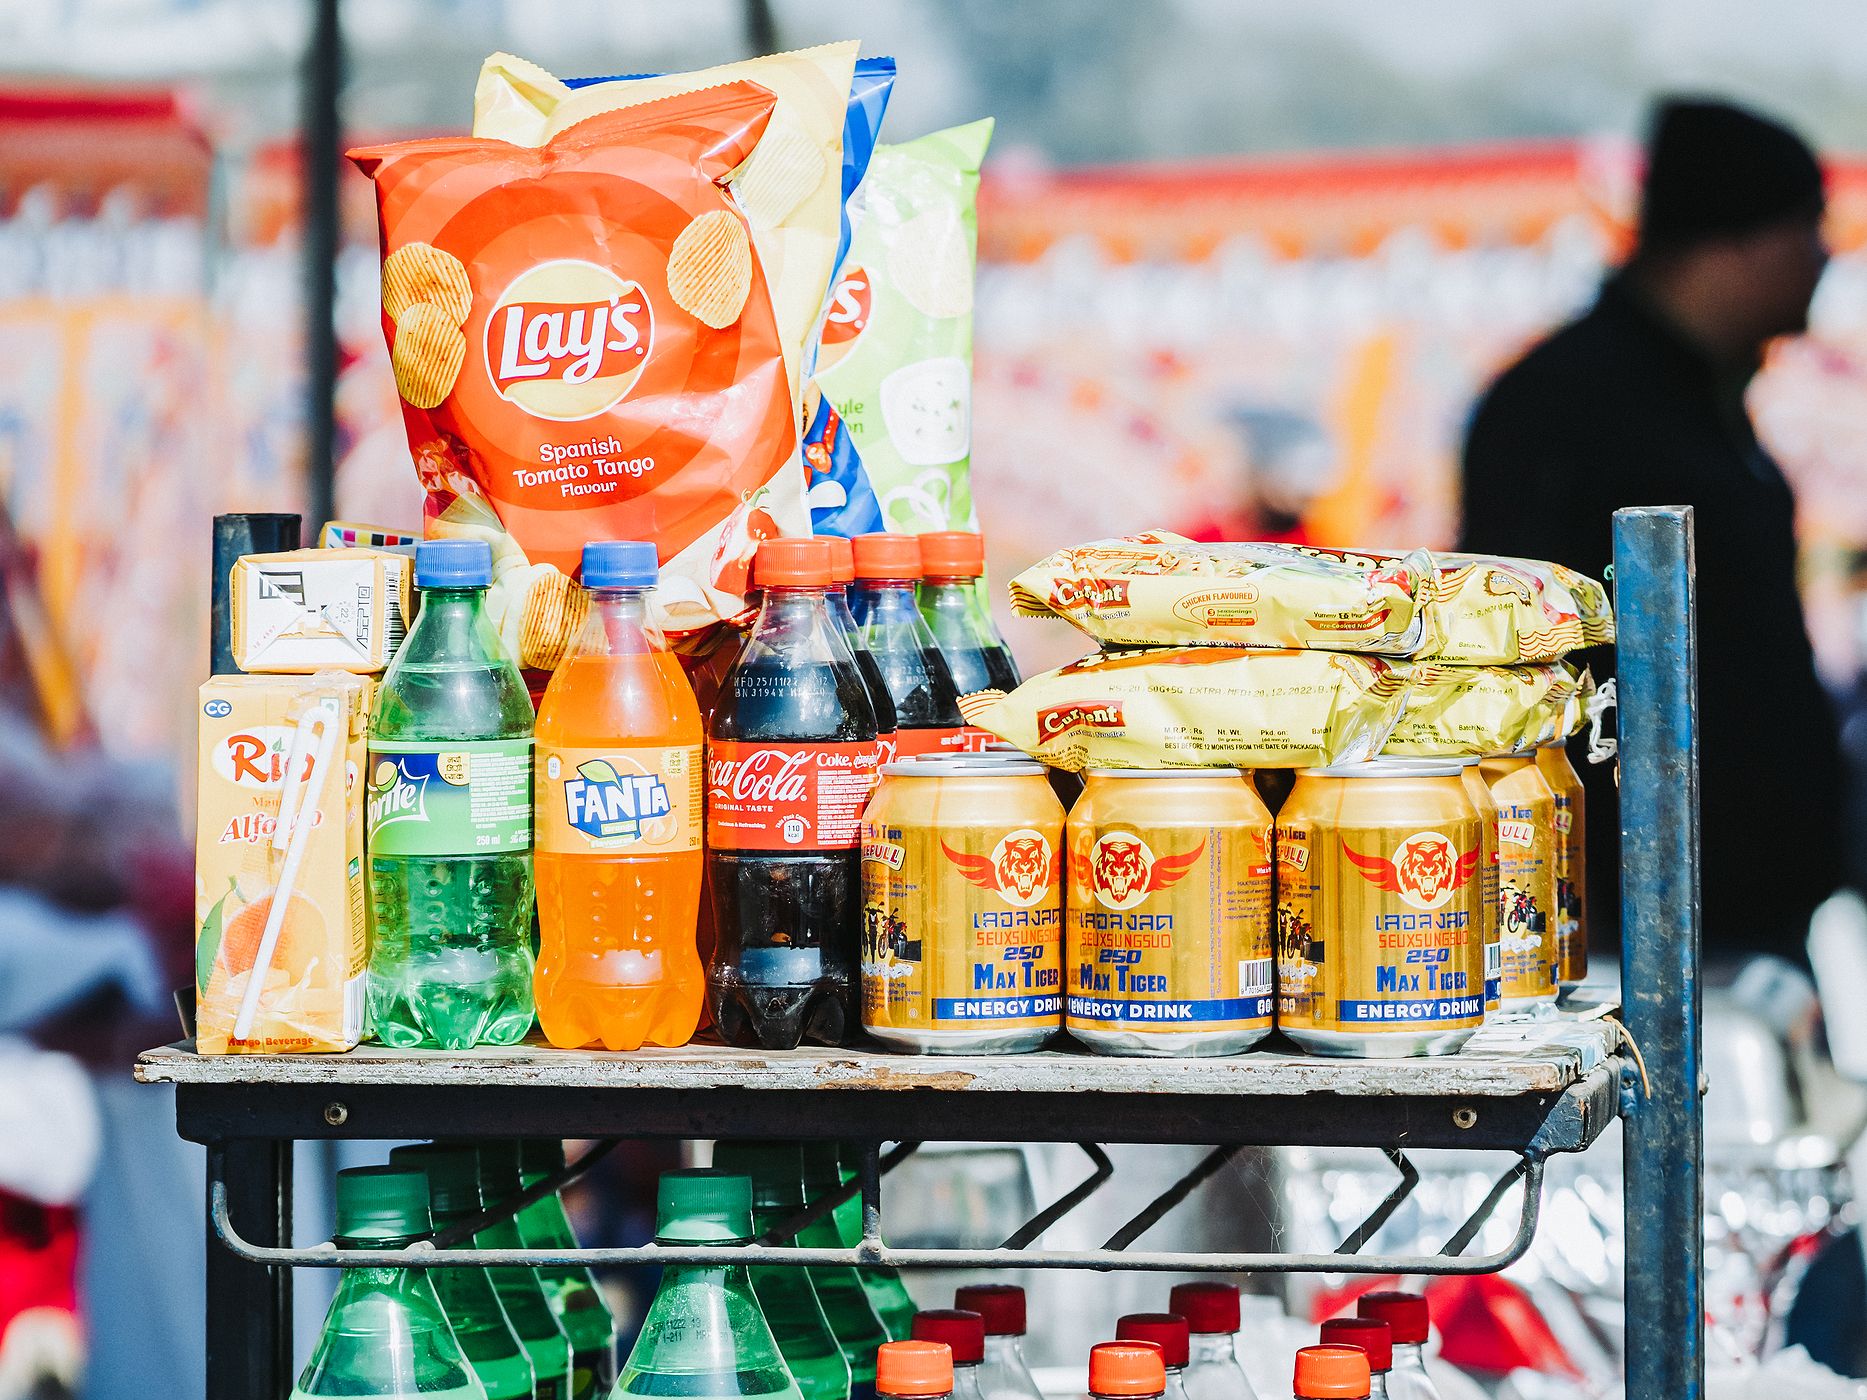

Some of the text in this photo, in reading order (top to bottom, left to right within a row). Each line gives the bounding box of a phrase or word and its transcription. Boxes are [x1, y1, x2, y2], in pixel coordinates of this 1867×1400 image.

[499, 294, 641, 385] Lay's
[539, 435, 622, 464] Spanish
[513, 456, 655, 488] Tomato Tango
[561, 480, 617, 498] Flavour
[1181, 592, 1253, 609] CHICKEN FLAVOURED
[356, 586, 371, 650] ASEPTO
[1313, 611, 1336, 619] Yummy
[751, 688, 784, 698] 3194X
[205, 702, 231, 716] CG
[1044, 705, 1118, 733] Current
[1229, 728, 1242, 736] Wt.
[1181, 742, 1203, 750] BEFORE
[1211, 743, 1235, 751] MONTHS
[252, 796, 282, 808] Man
[565, 776, 670, 824] FANTA
[714, 803, 774, 813] ORIGINAL TASTE
[220, 811, 323, 843] Alfo
[787, 824, 800, 832] 110
[1502, 825, 1529, 842] ULL
[475, 835, 490, 846] 250
[1003, 945, 1044, 961] 250
[1098, 949, 1142, 964] 250
[1405, 948, 1450, 964] 250
[973, 961, 1059, 990] MAX TIGER
[1080, 963, 1167, 993] MAX TIGER
[1376, 964, 1467, 993] MAX TIGER
[953, 997, 1064, 1017] ENERGY DRIN
[1071, 1000, 1193, 1019] ENERGY DRINK
[1357, 998, 1480, 1019] ENERGY DRINK
[265, 1037, 314, 1047] Beverage
